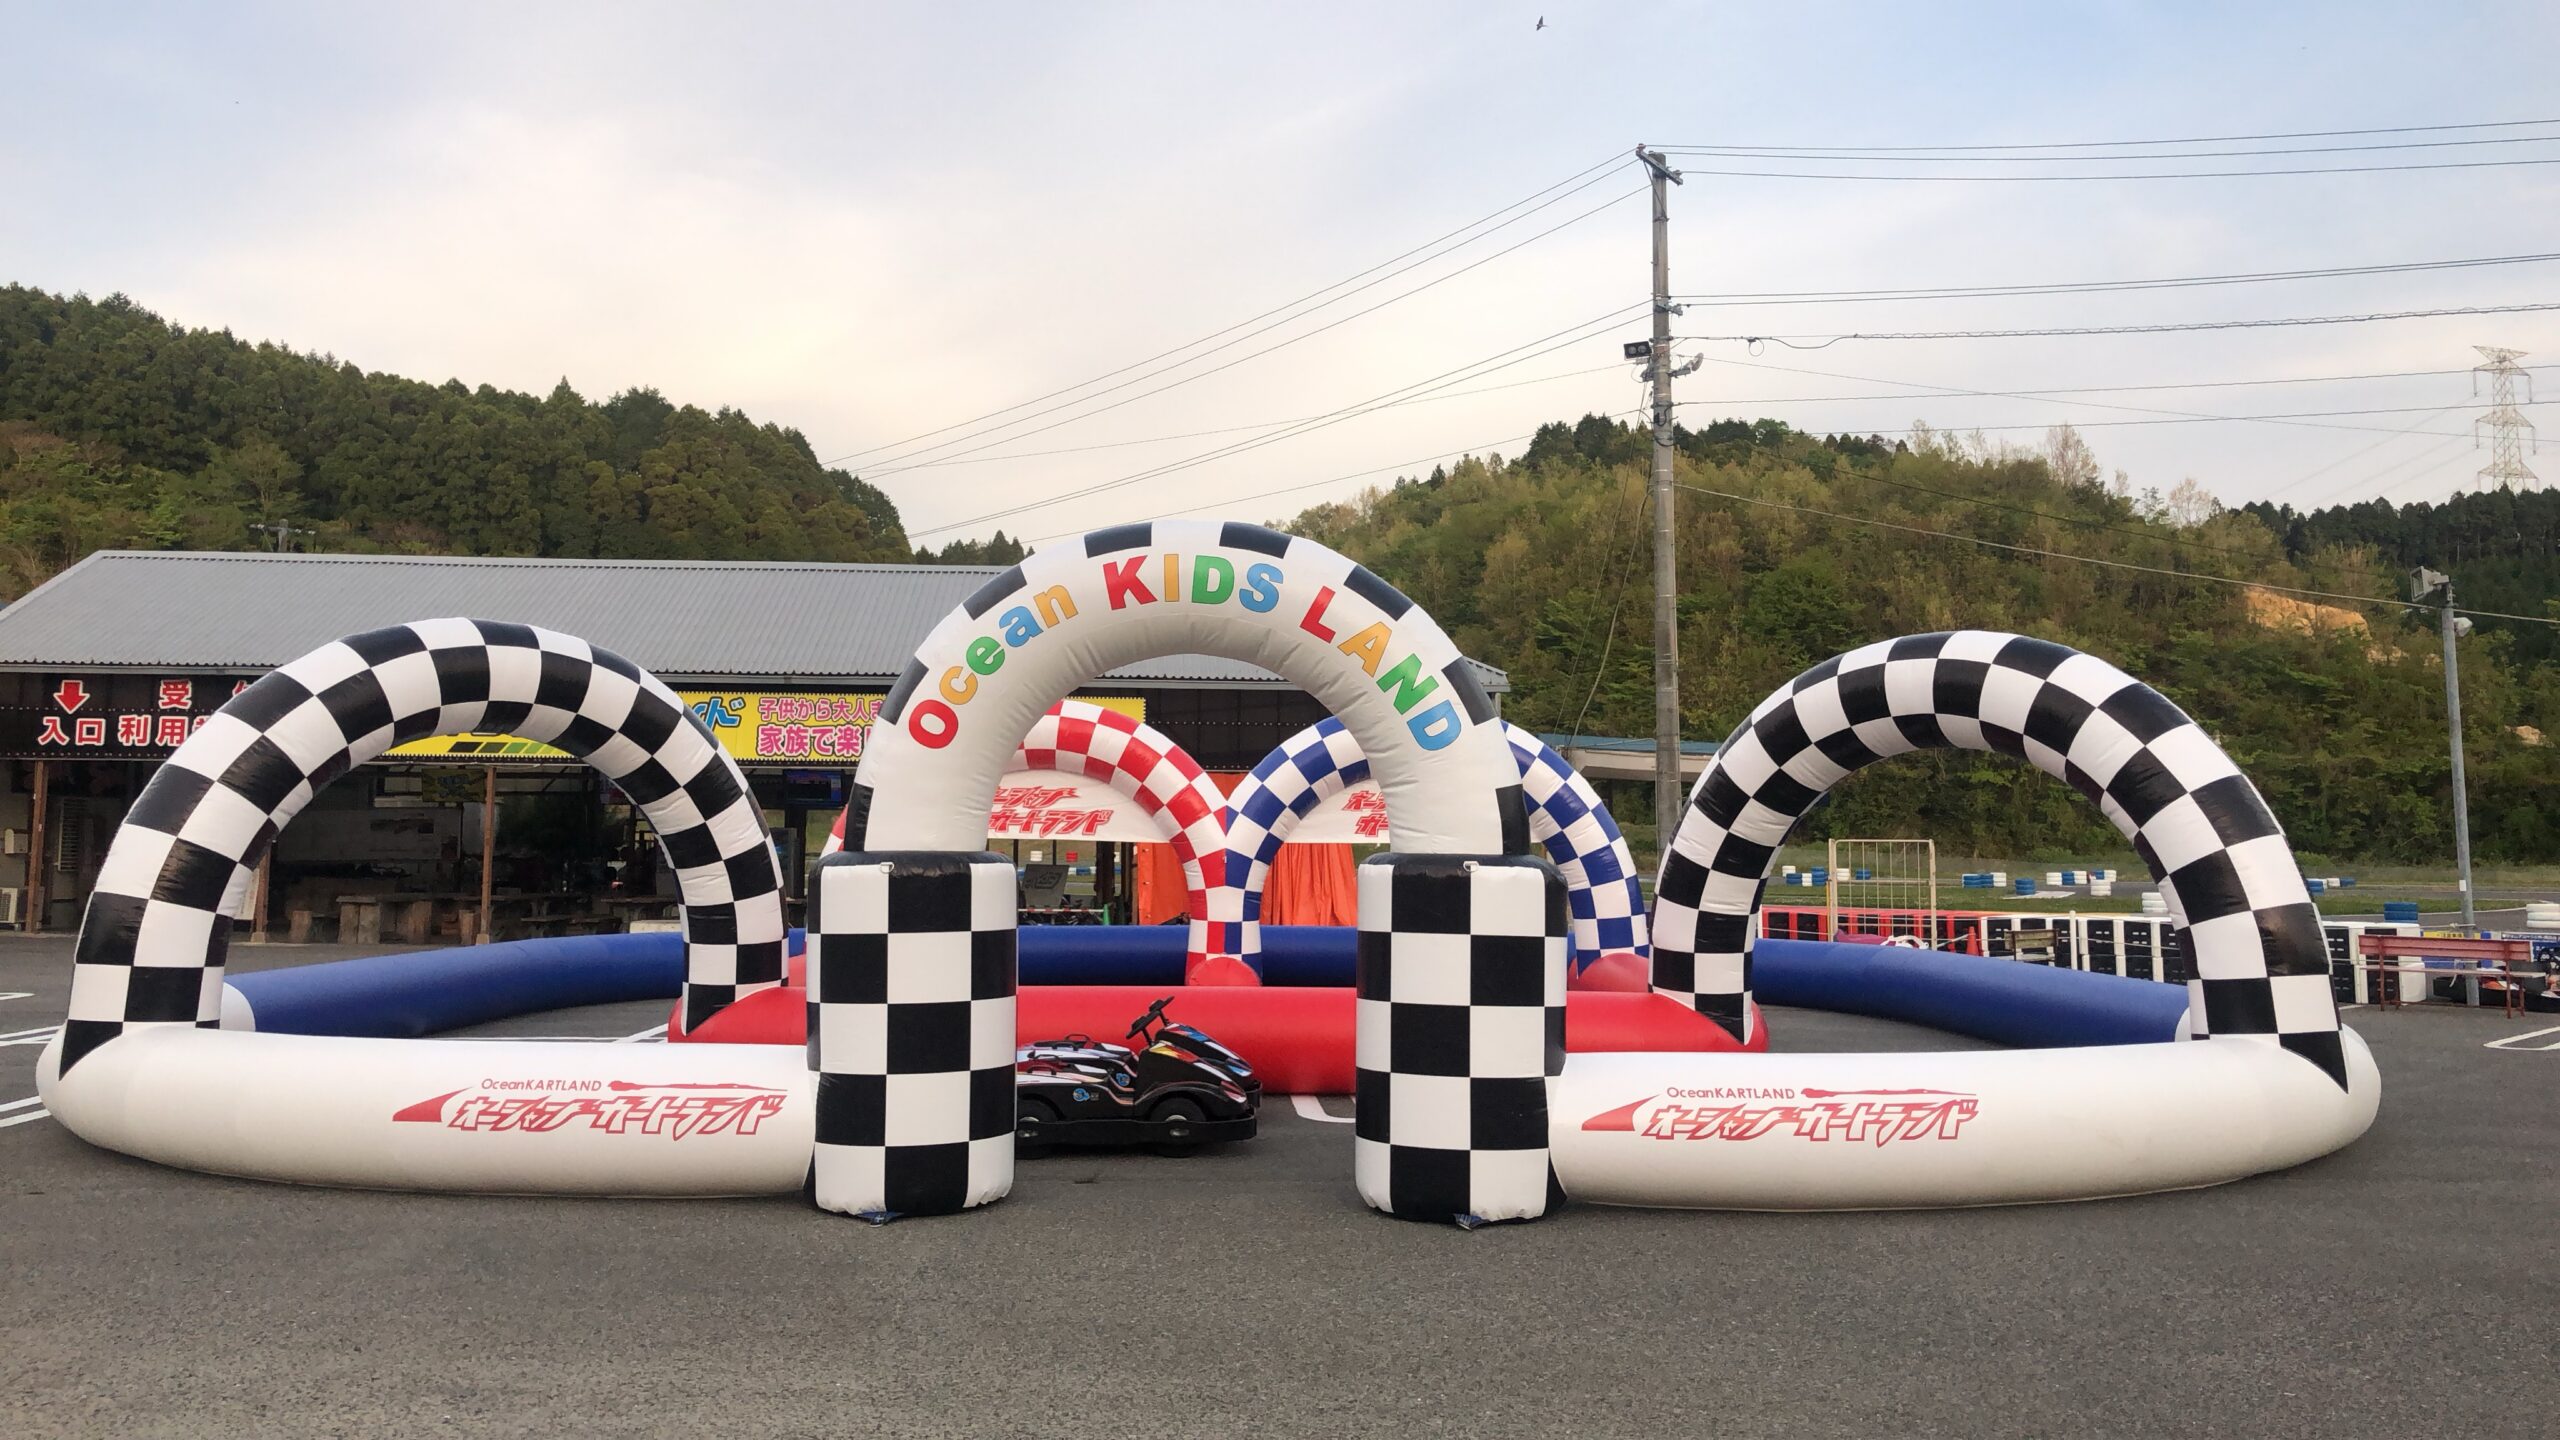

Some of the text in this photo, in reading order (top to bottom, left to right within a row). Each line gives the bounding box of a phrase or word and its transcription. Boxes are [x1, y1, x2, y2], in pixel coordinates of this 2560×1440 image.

[908, 553, 1462, 751] Ocean KIDS LAND
[37, 714, 210, 747] 入口 利用
